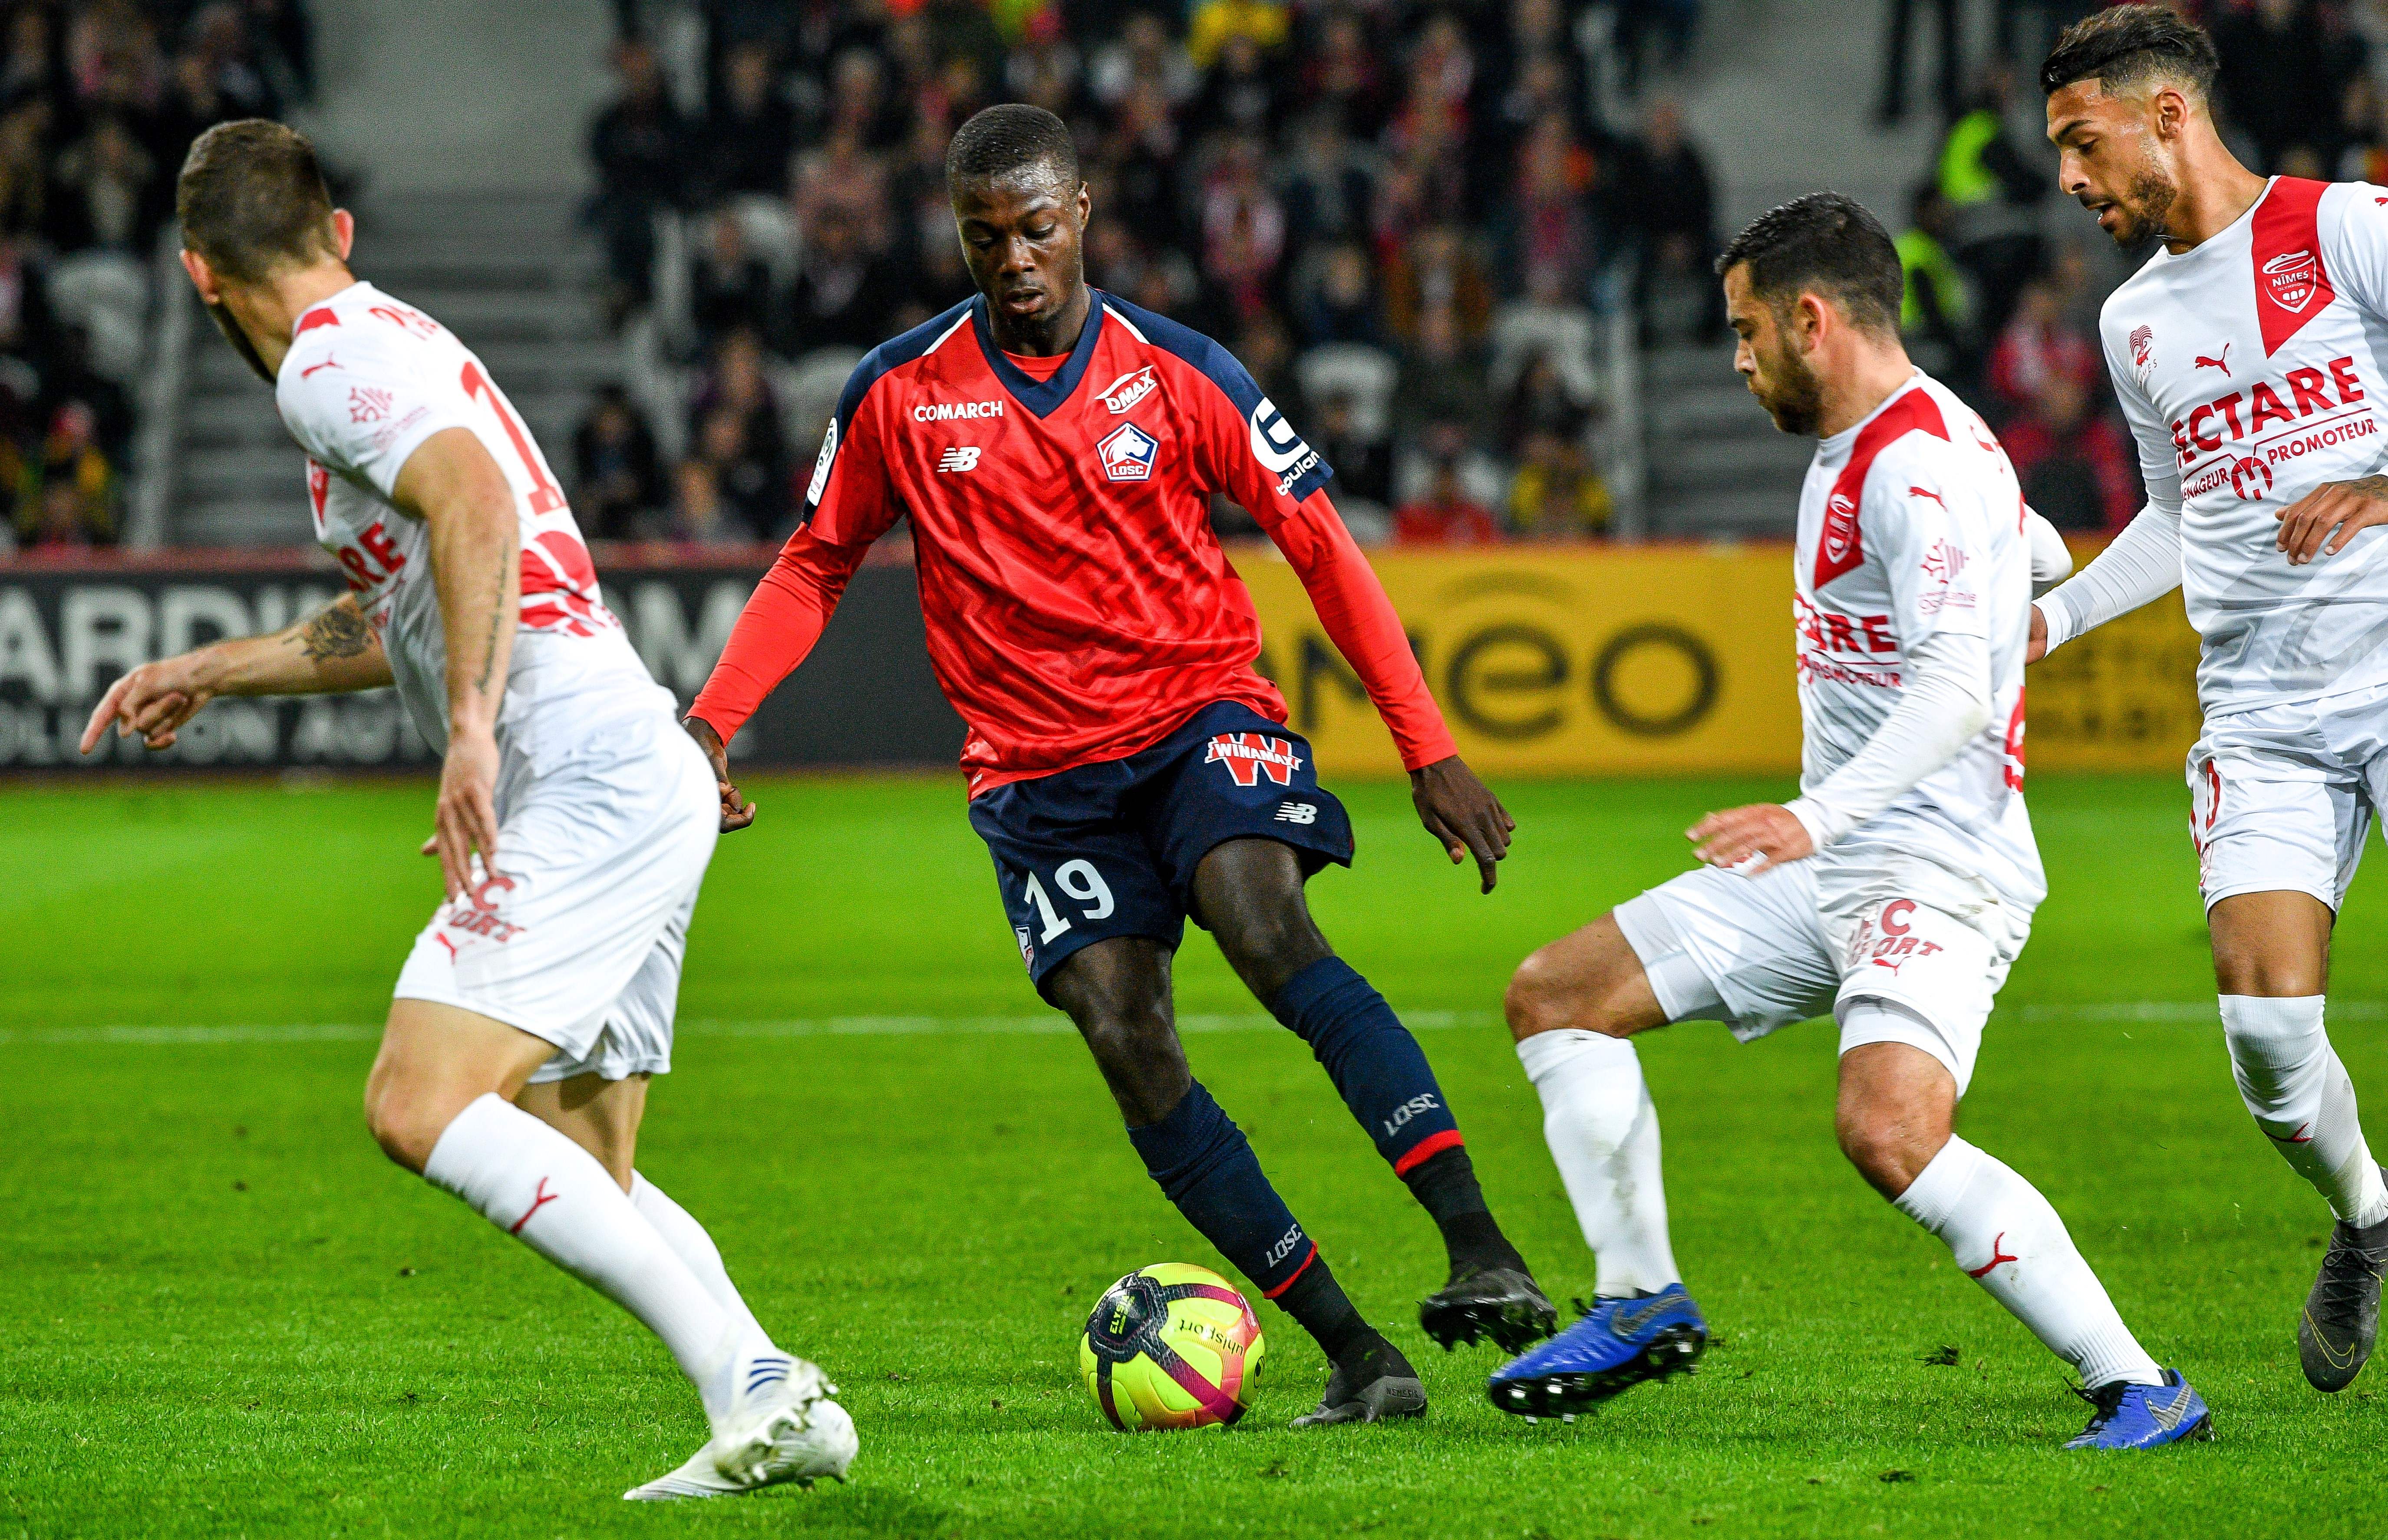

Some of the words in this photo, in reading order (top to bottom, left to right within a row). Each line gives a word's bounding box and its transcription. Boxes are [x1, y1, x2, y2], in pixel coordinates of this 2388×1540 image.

[2272, 270, 2309, 287] NÎMES
[914, 400, 1003, 422] COMARCH
[1105, 370, 1155, 411] DMAX
[2267, 418, 2378, 465] PROMOTEUR
[1112, 465, 1144, 476] LOSC
[1276, 451, 1320, 496] boulan
[1214, 743, 1293, 767] WINAMAX
[1024, 859, 1115, 945] 19
[1383, 1093, 1440, 1137] LOSC
[1266, 1224, 1302, 1267] LOSC
[1181, 1319, 1244, 1357] uhlsport
